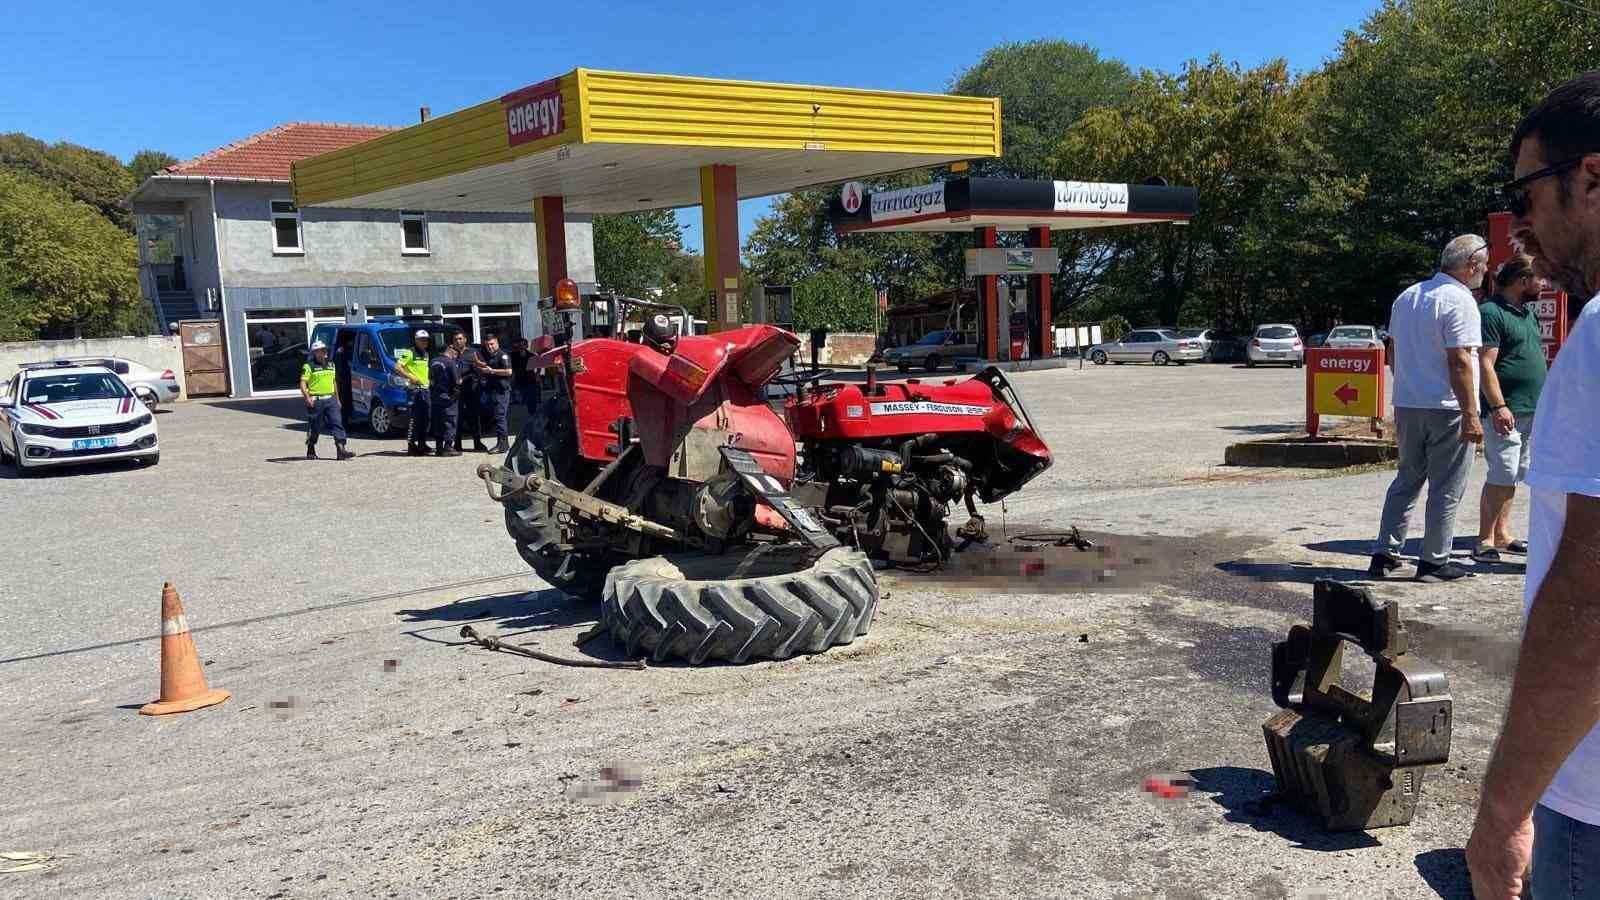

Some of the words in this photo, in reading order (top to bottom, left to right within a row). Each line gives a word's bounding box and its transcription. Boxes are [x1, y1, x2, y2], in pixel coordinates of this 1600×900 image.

[508, 96, 560, 136] energy
[1320, 358, 1371, 372] energy
[884, 403, 920, 413] MASSEY
